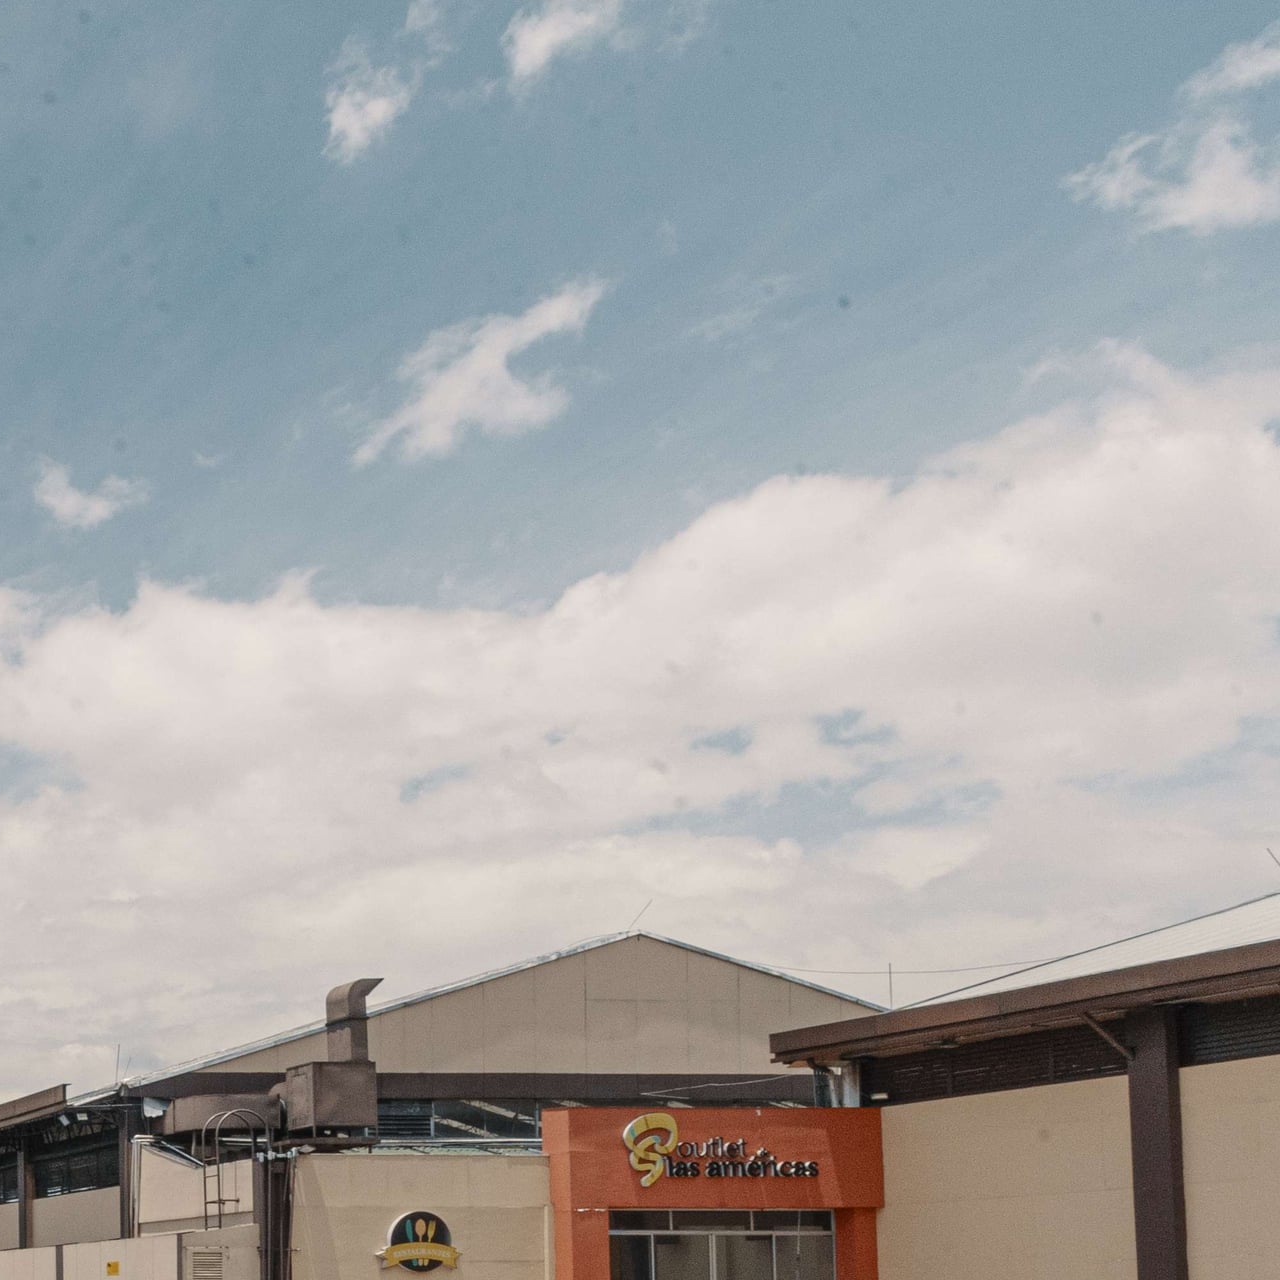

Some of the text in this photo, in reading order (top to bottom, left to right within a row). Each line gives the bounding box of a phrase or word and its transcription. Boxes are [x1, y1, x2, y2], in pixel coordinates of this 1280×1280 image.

[676, 1136, 747, 1158] outlet
[663, 1154, 819, 1178] las américas
